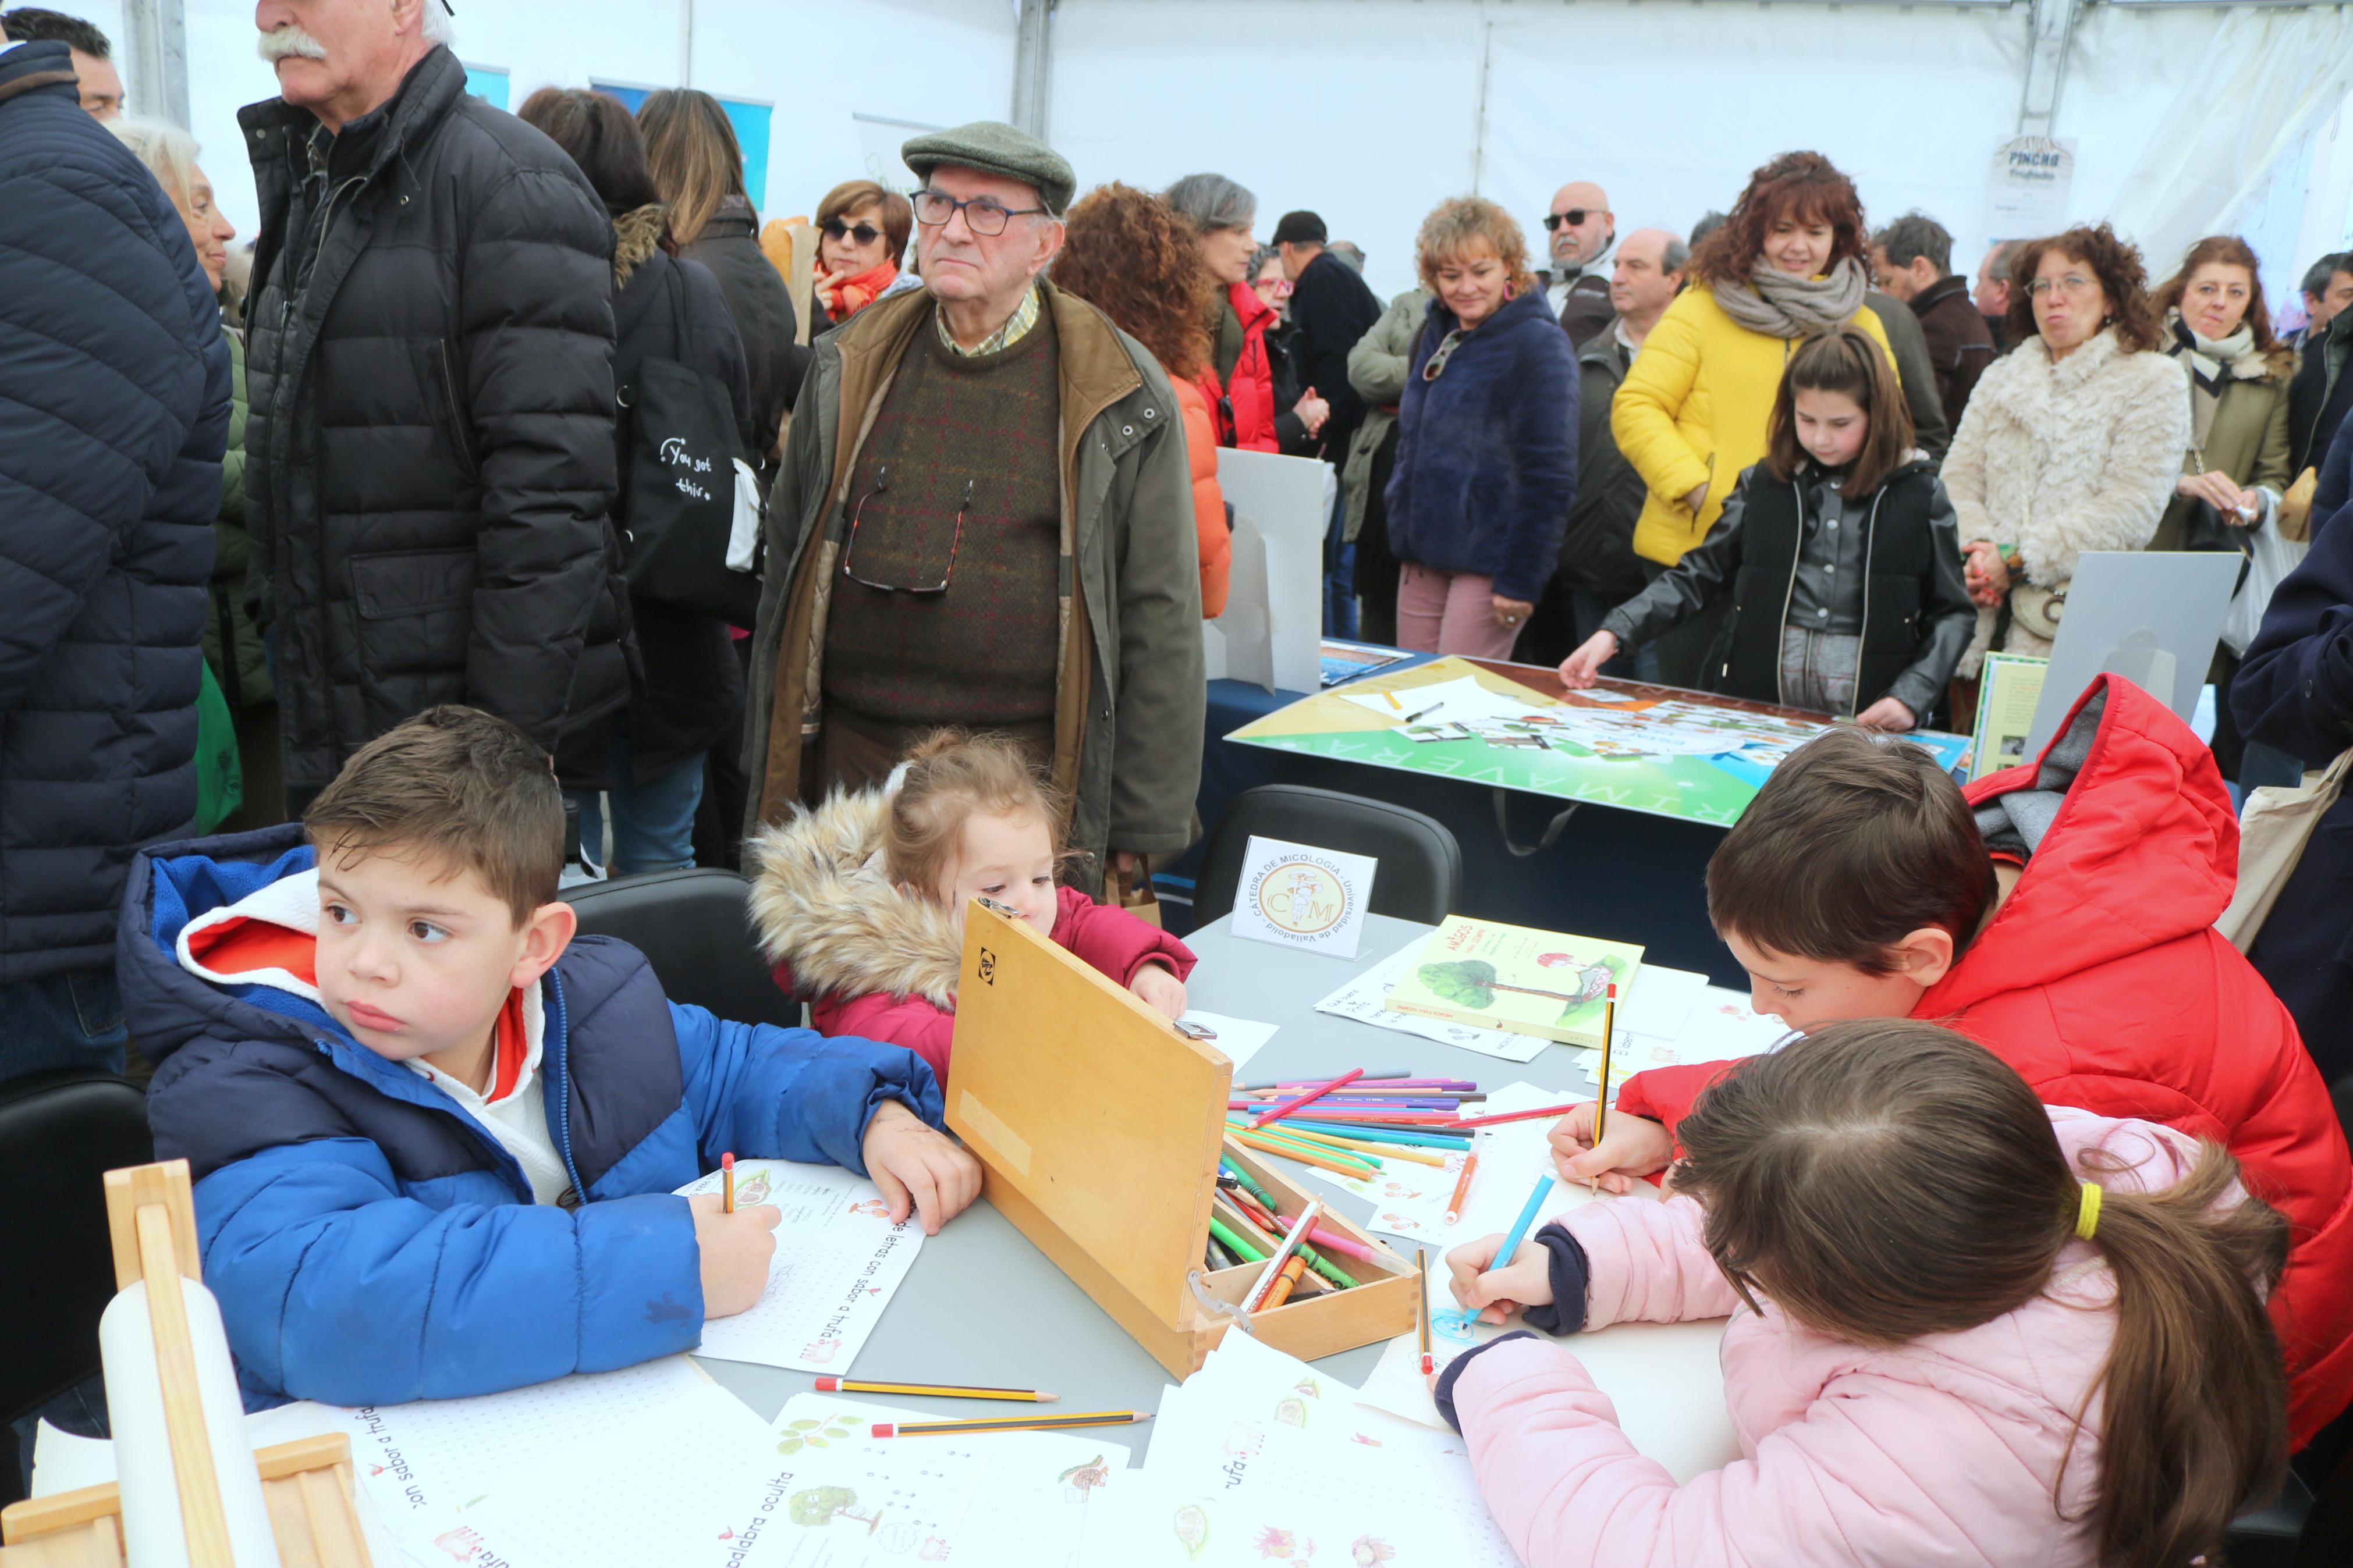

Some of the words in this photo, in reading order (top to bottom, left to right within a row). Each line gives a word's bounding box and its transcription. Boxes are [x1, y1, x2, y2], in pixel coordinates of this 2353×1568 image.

[2009, 151, 2059, 167] PINCHO
[670, 446, 691, 465] You
[694, 457, 711, 472] got
[675, 478, 702, 498] this
[1264, 859, 1279, 872] DE
[1332, 880, 1355, 931] Universidad
[1265, 922, 1316, 943] Valladolid
[1319, 930, 1331, 939] de
[1446, 925, 1473, 951] AMIGOS
[892, 1221, 911, 1232] de
[875, 1234, 905, 1258] letras
[862, 1260, 881, 1276] con
[844, 1278, 870, 1303] sabor
[819, 1315, 850, 1339] trufa
[354, 1406, 386, 1435] trufa
[376, 1435, 391, 1444] a
[382, 1447, 414, 1481] sabor
[725, 1517, 768, 1568] palabra
[761, 1471, 795, 1512] oculta
